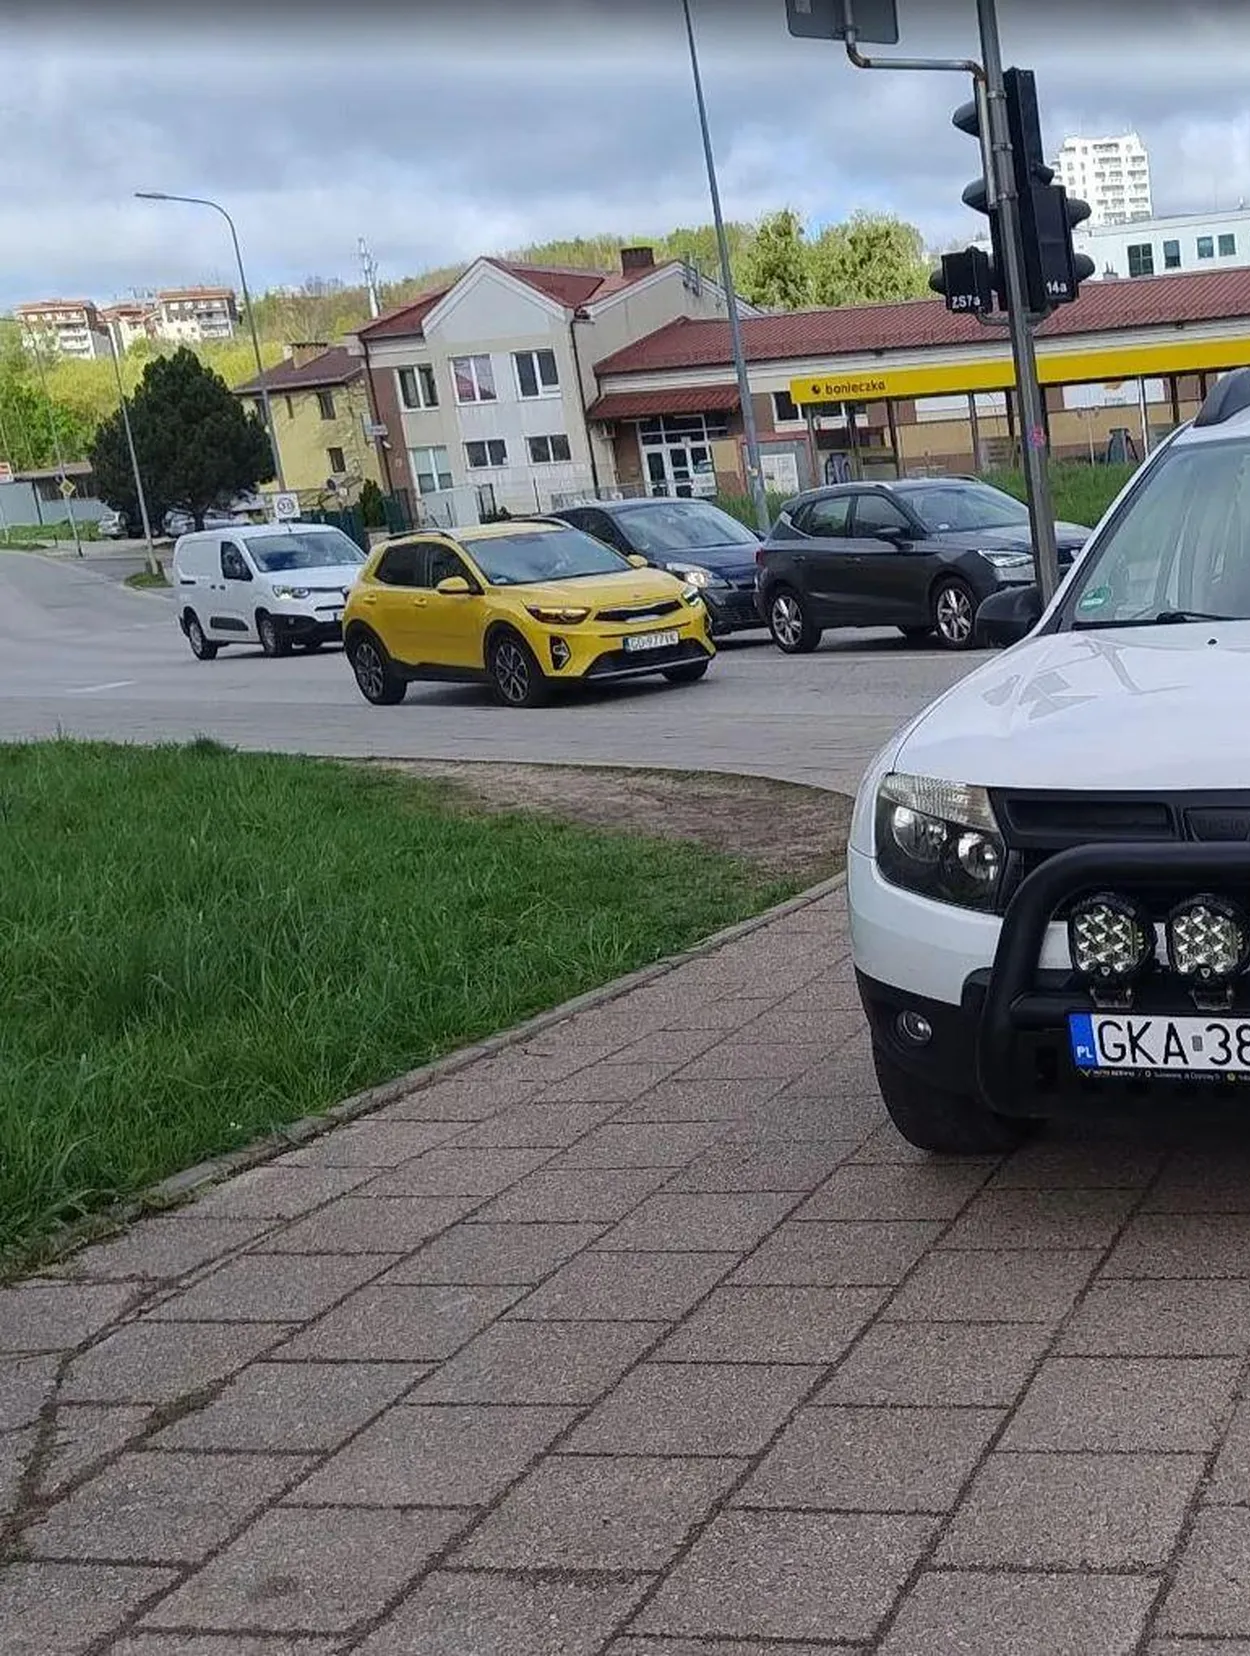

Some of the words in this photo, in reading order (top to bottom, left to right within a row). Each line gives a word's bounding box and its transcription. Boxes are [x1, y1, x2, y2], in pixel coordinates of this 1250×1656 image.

[1046, 281, 1068, 294] 14a
[1097, 1020, 1189, 1065] GKA
[1076, 1045, 1093, 1059] PL
